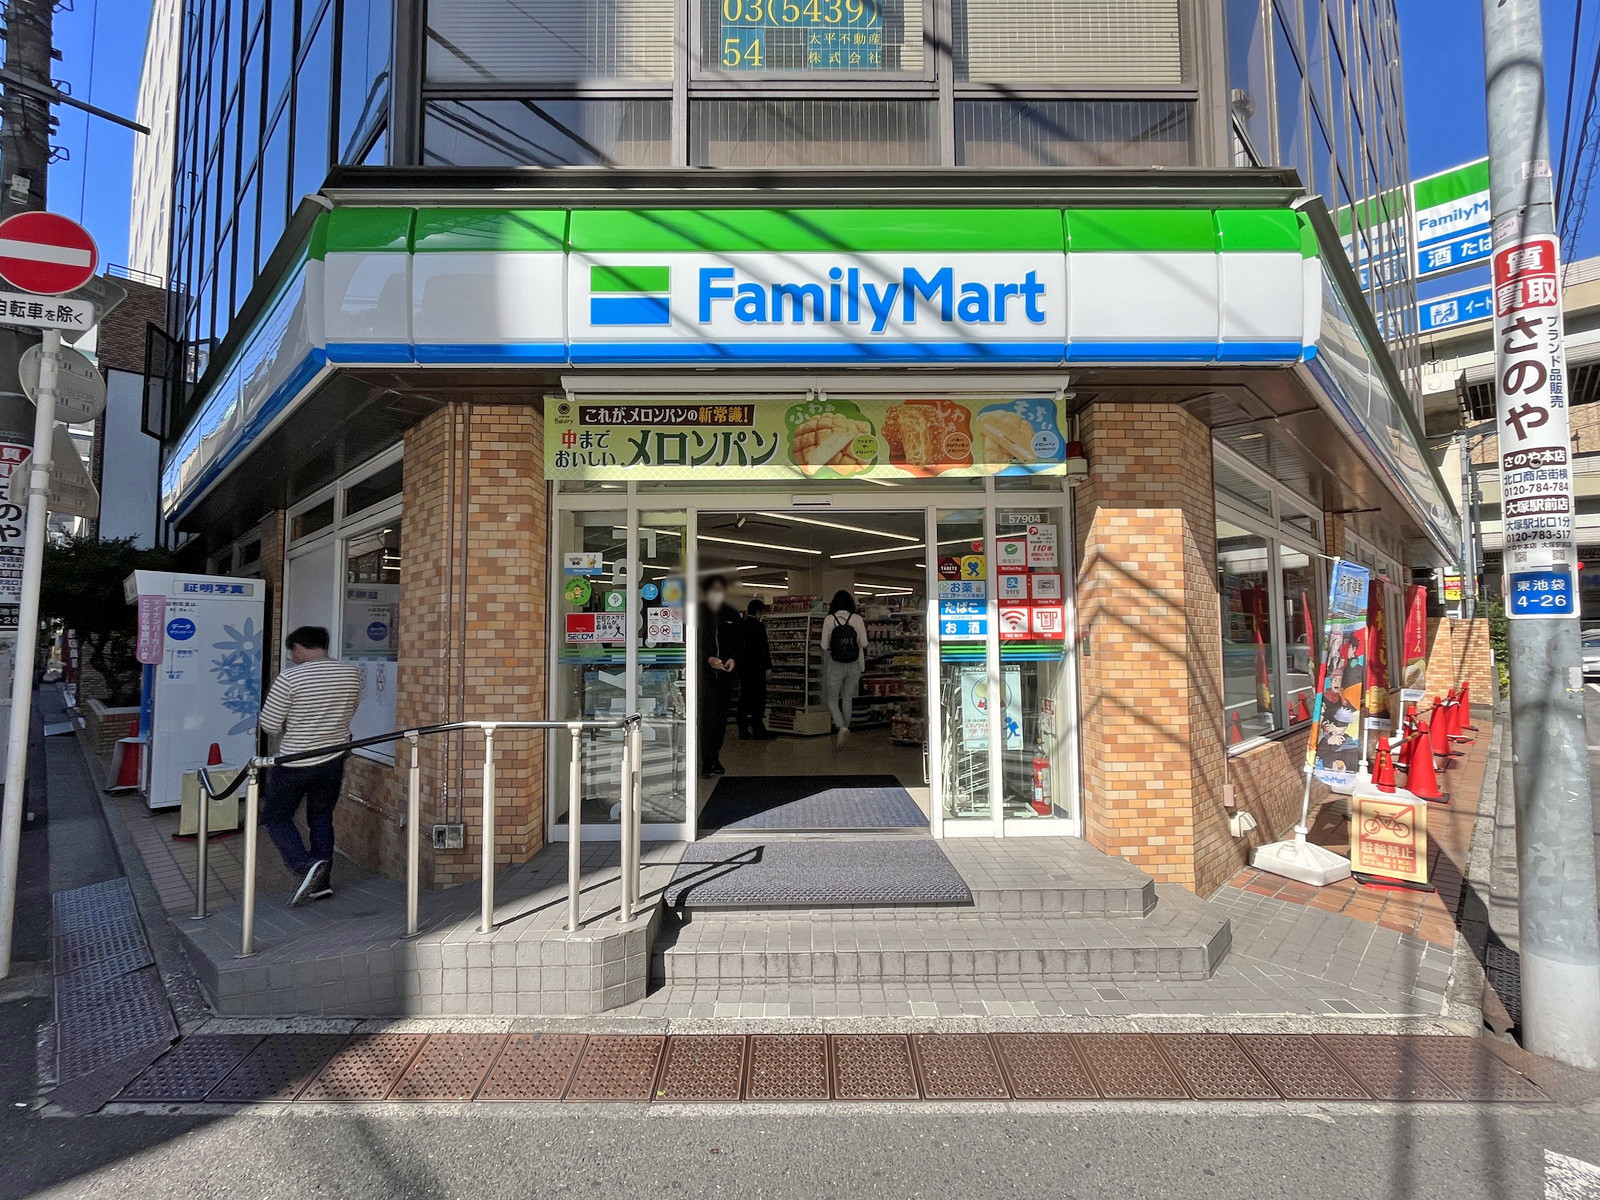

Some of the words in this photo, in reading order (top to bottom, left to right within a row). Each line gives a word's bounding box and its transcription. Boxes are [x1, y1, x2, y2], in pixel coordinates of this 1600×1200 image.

[808, 32, 882, 46] 太平不動産
[808, 51, 882, 65] 株式会社
[1419, 199, 1489, 232] FamilyM
[1428, 245, 1453, 269] 酒
[1460, 235, 1493, 257] たば
[1505, 245, 1543, 278] 質
[698, 266, 1047, 335] FamilyMart
[1465, 296, 1492, 314] イート
[1497, 277, 1557, 315] 買取
[1546, 315, 1565, 409] ブランド品販売
[1501, 316, 1550, 442] さのや
[554, 418, 574, 426] Bakery
[561, 429, 612, 450] 中まで
[621, 429, 779, 469] メロンパン
[555, 450, 616, 469] おいしい
[1503, 449, 1566, 469] さのや本店
[1503, 468, 1569, 486] 北口商店街横
[1504, 482, 1570, 498] 0120-784-784
[1506, 498, 1570, 516] 大塚駅前店
[1008, 514, 1042, 524] 57904
[1506, 516, 1571, 532] 大塚駅北口1分
[1506, 529, 1572, 544] 0120-783-517
[183, 583, 245, 595] 証明写真
[950, 582, 973, 593] お薬
[1516, 579, 1566, 591] 東池袋
[944, 602, 979, 613] たばこ
[1517, 594, 1567, 608] 4-26
[945, 622, 981, 634] お酒
[1361, 841, 1414, 860] 駐輪禁止
